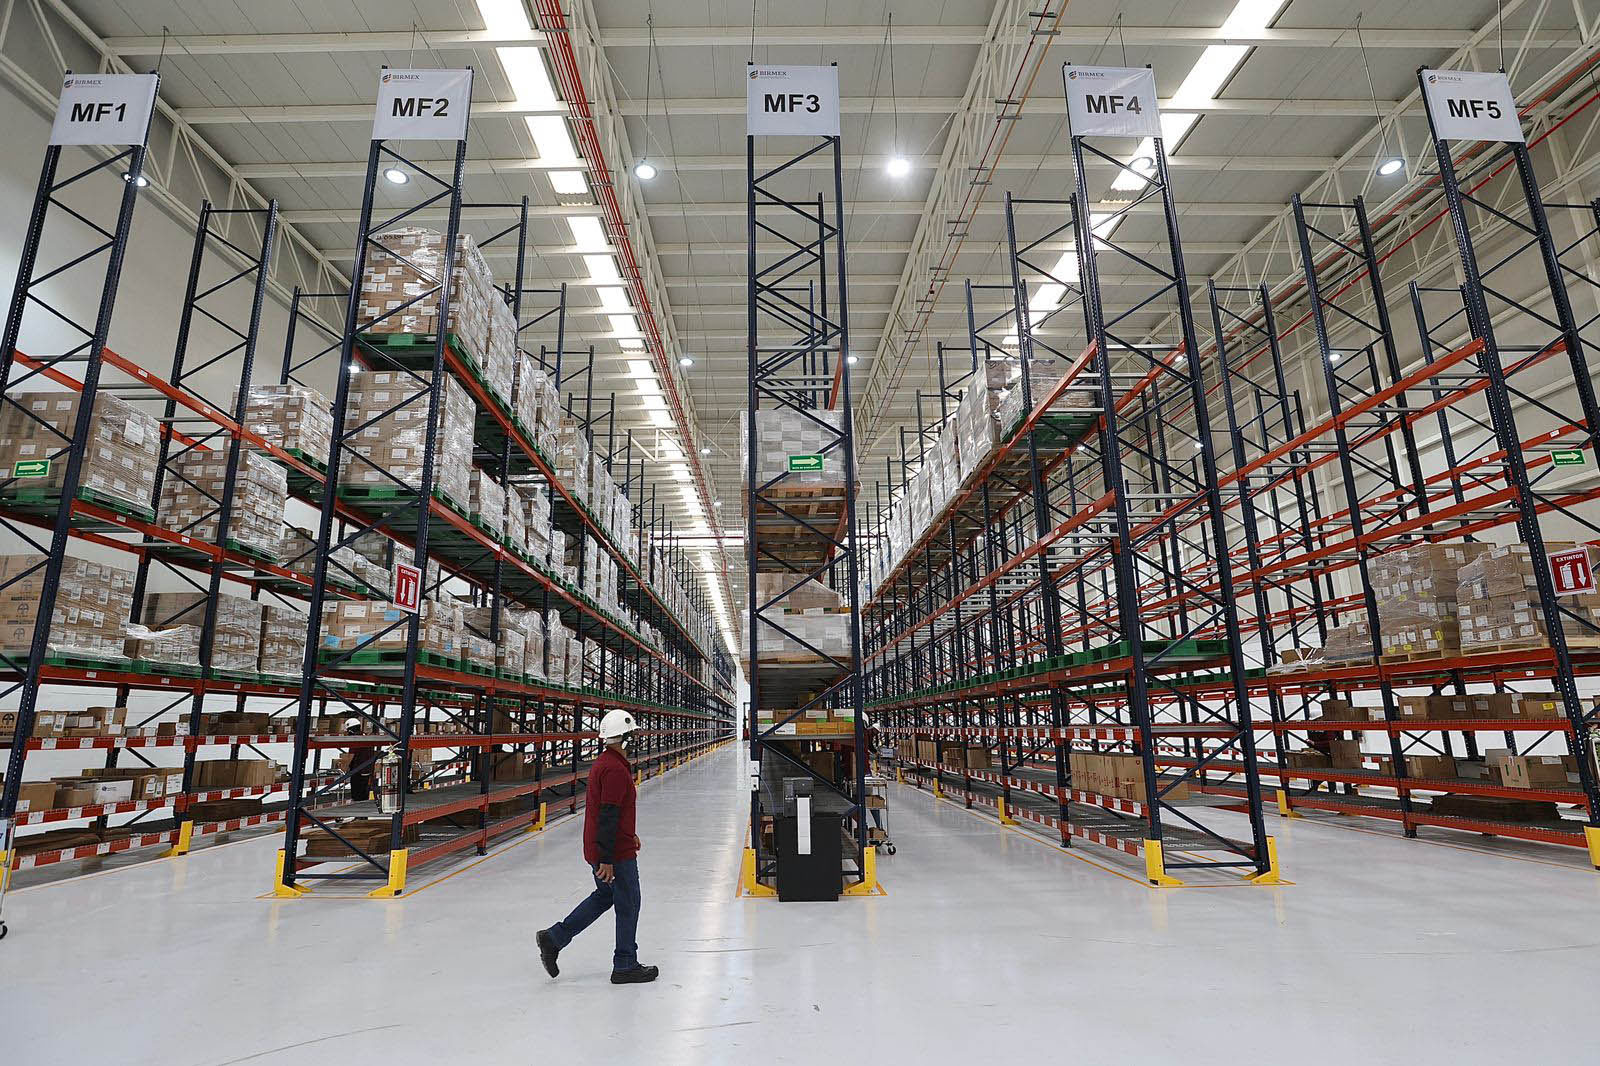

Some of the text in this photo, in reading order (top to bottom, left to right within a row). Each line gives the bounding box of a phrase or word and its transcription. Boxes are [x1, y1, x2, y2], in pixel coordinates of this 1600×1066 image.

[70, 103, 126, 122] MF1
[392, 98, 449, 117] MF2
[764, 94, 820, 113] MF3
[1086, 94, 1142, 115] MF4
[1447, 99, 1502, 119] MF5
[1556, 553, 1584, 562] EXTINTOR
